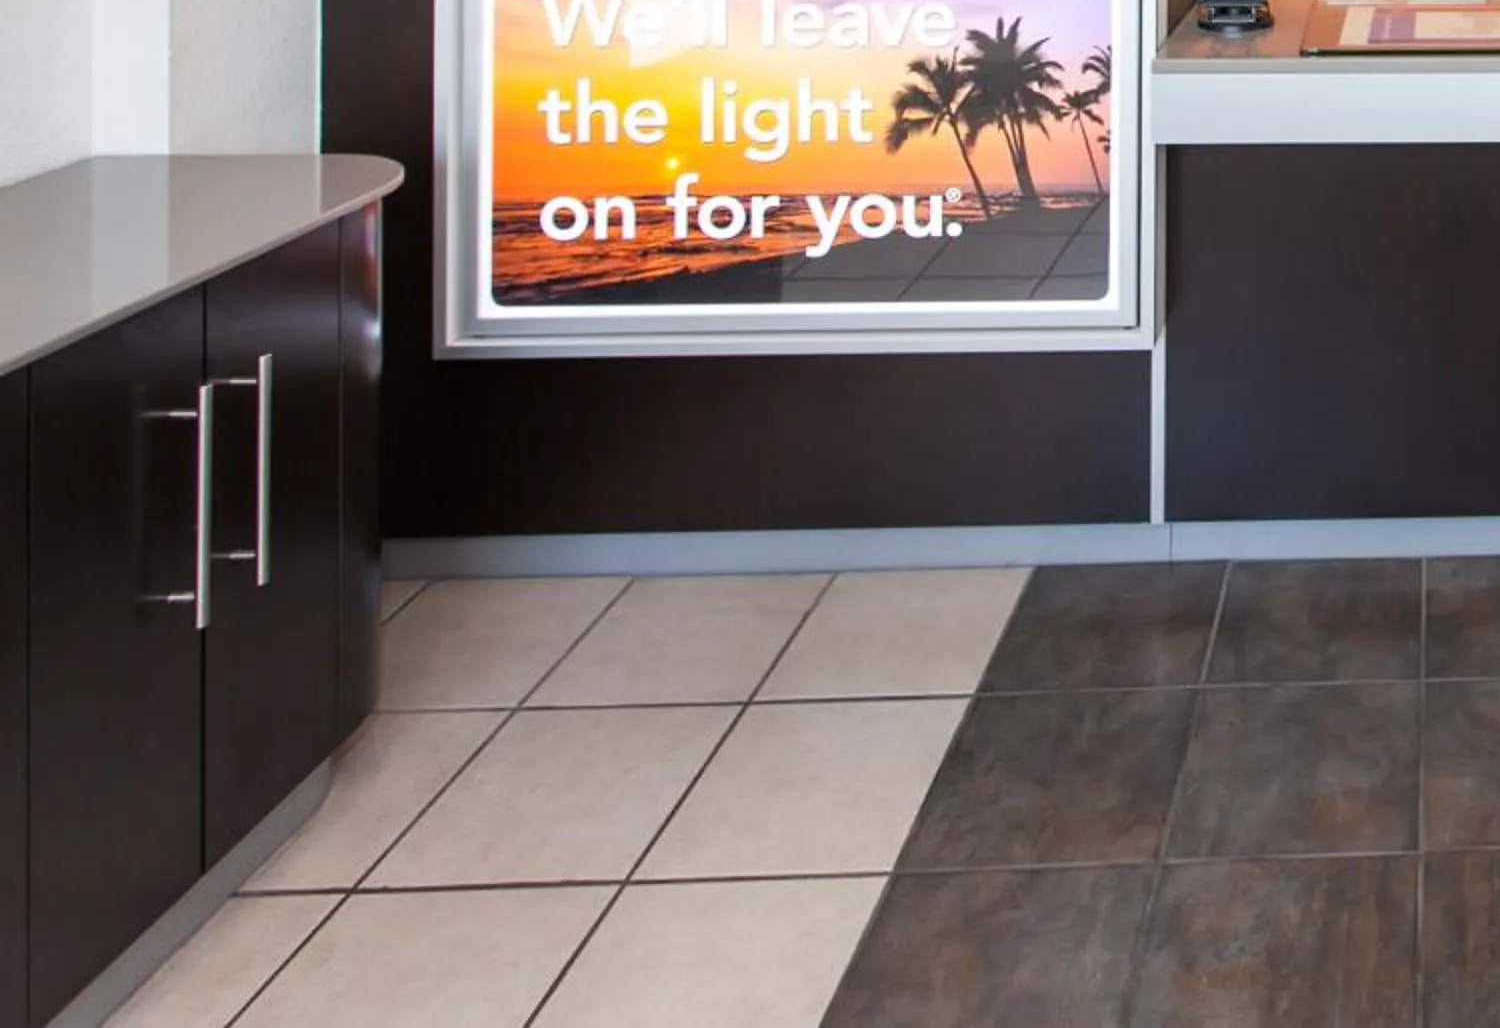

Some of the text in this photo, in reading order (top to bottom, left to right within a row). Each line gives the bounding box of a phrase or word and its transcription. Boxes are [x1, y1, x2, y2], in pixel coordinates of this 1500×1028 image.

[538, 77, 873, 164] the light
[539, 194, 635, 242] on
[668, 174, 781, 241] for
